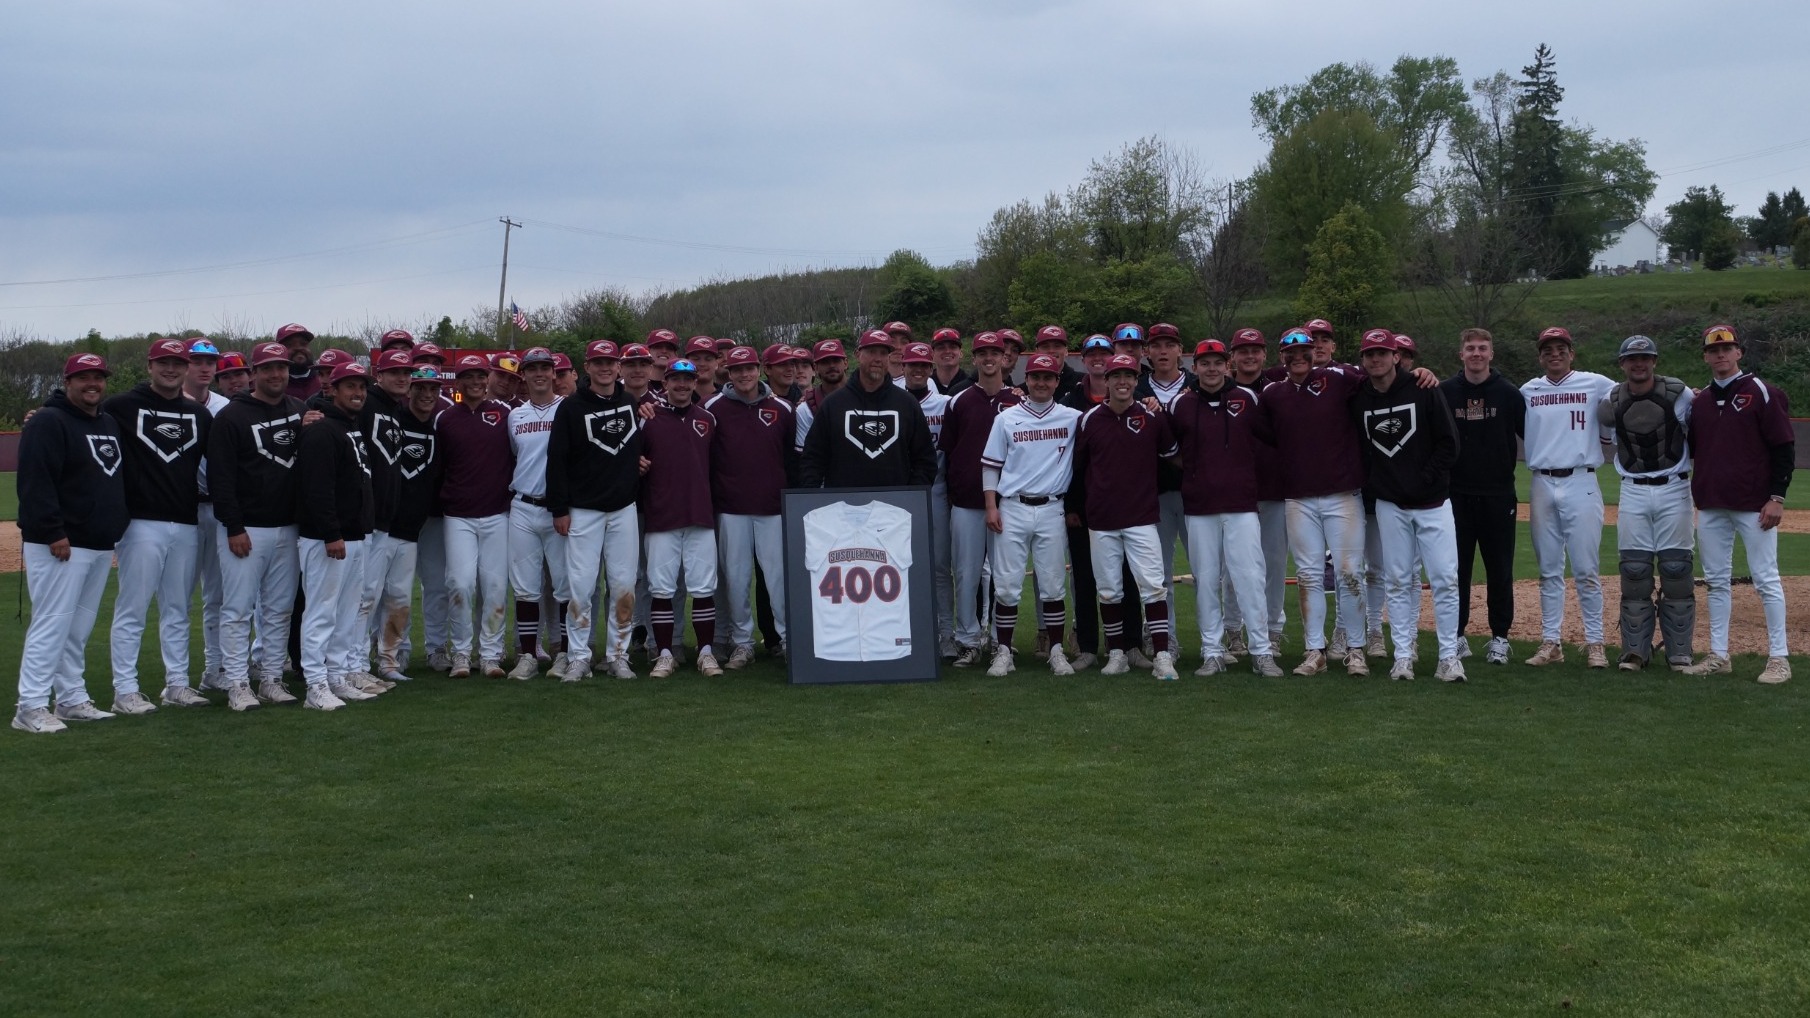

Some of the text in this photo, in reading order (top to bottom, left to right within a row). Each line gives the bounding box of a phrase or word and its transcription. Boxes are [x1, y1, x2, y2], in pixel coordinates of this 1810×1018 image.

[1530, 392, 1587, 408] SUSQUEHANNA
[1569, 410, 1587, 431] 14
[1012, 427, 1069, 443] SUSQUEHANNA
[1057, 445, 1067, 465] 7
[828, 547, 888, 564] SUSQUEHANNA
[818, 564, 902, 605] 400
